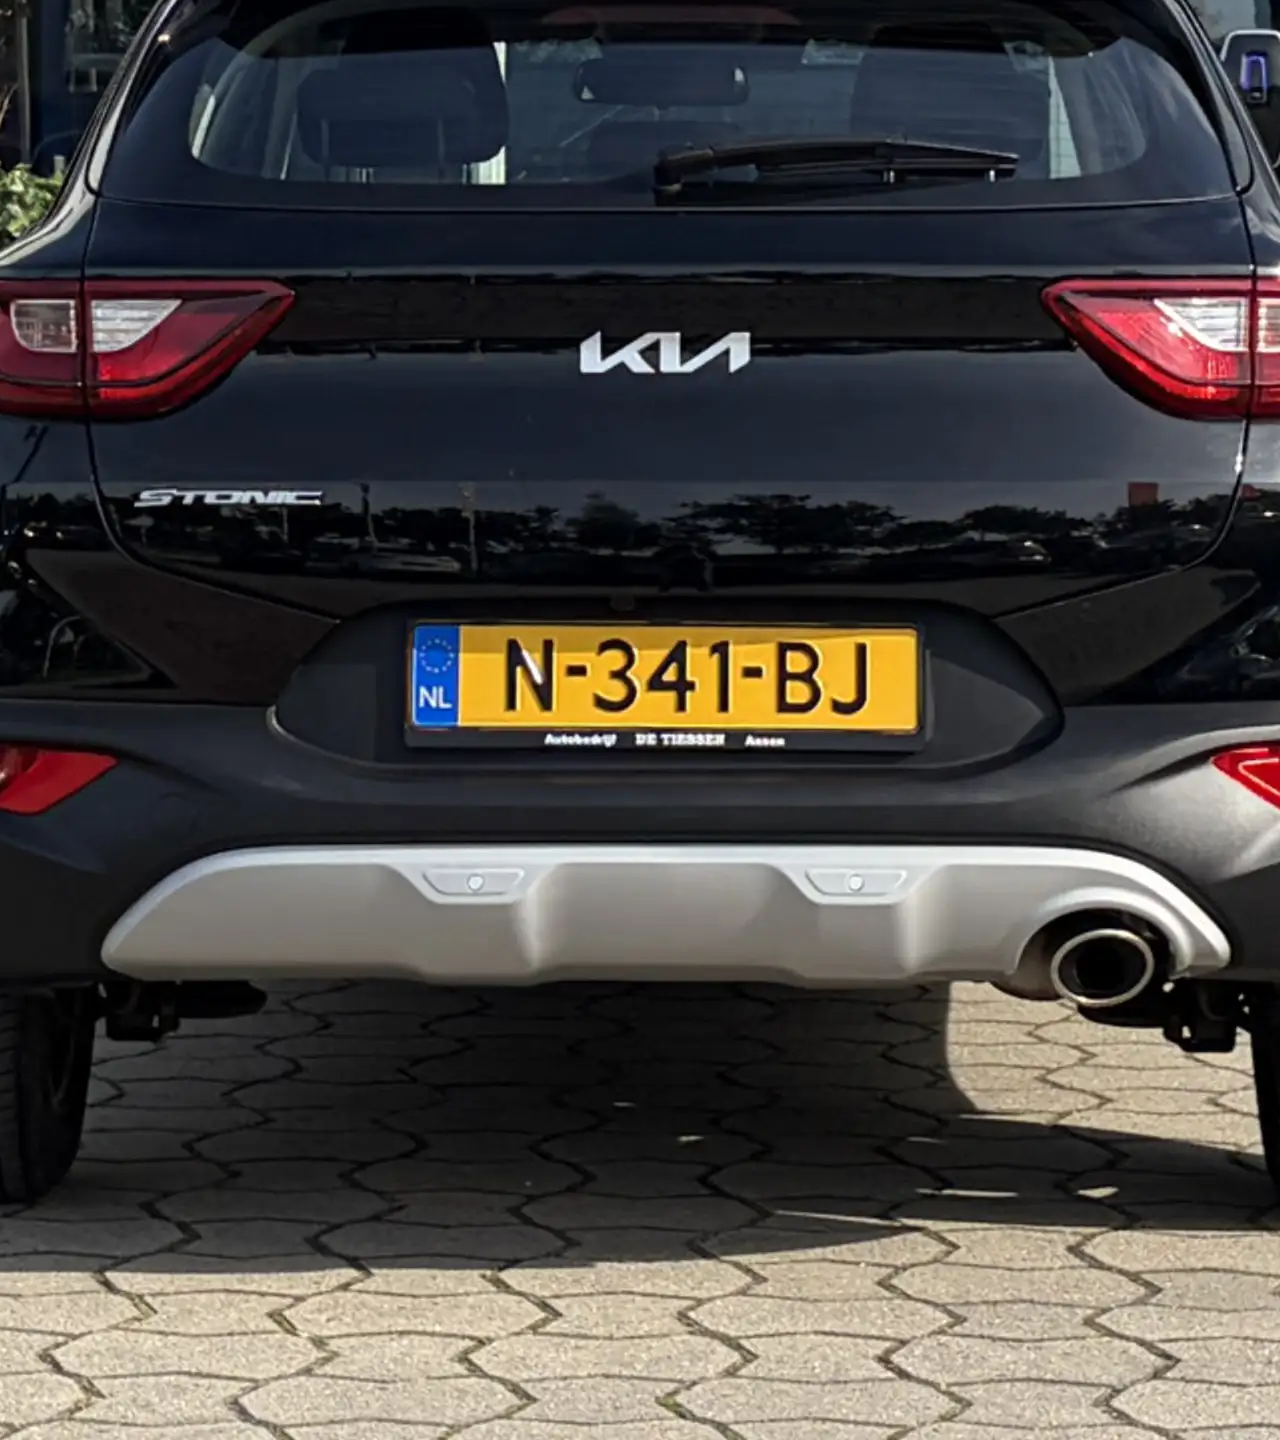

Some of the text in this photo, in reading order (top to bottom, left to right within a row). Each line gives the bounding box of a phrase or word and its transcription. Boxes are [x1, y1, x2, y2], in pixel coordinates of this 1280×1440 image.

[580, 331, 751, 374] KIA
[134, 488, 323, 508] STONIC
[504, 637, 869, 716] N-341-BJ
[419, 685, 452, 709] NL
[635, 733, 658, 746] DE
[660, 733, 726, 747] TIESSEN
